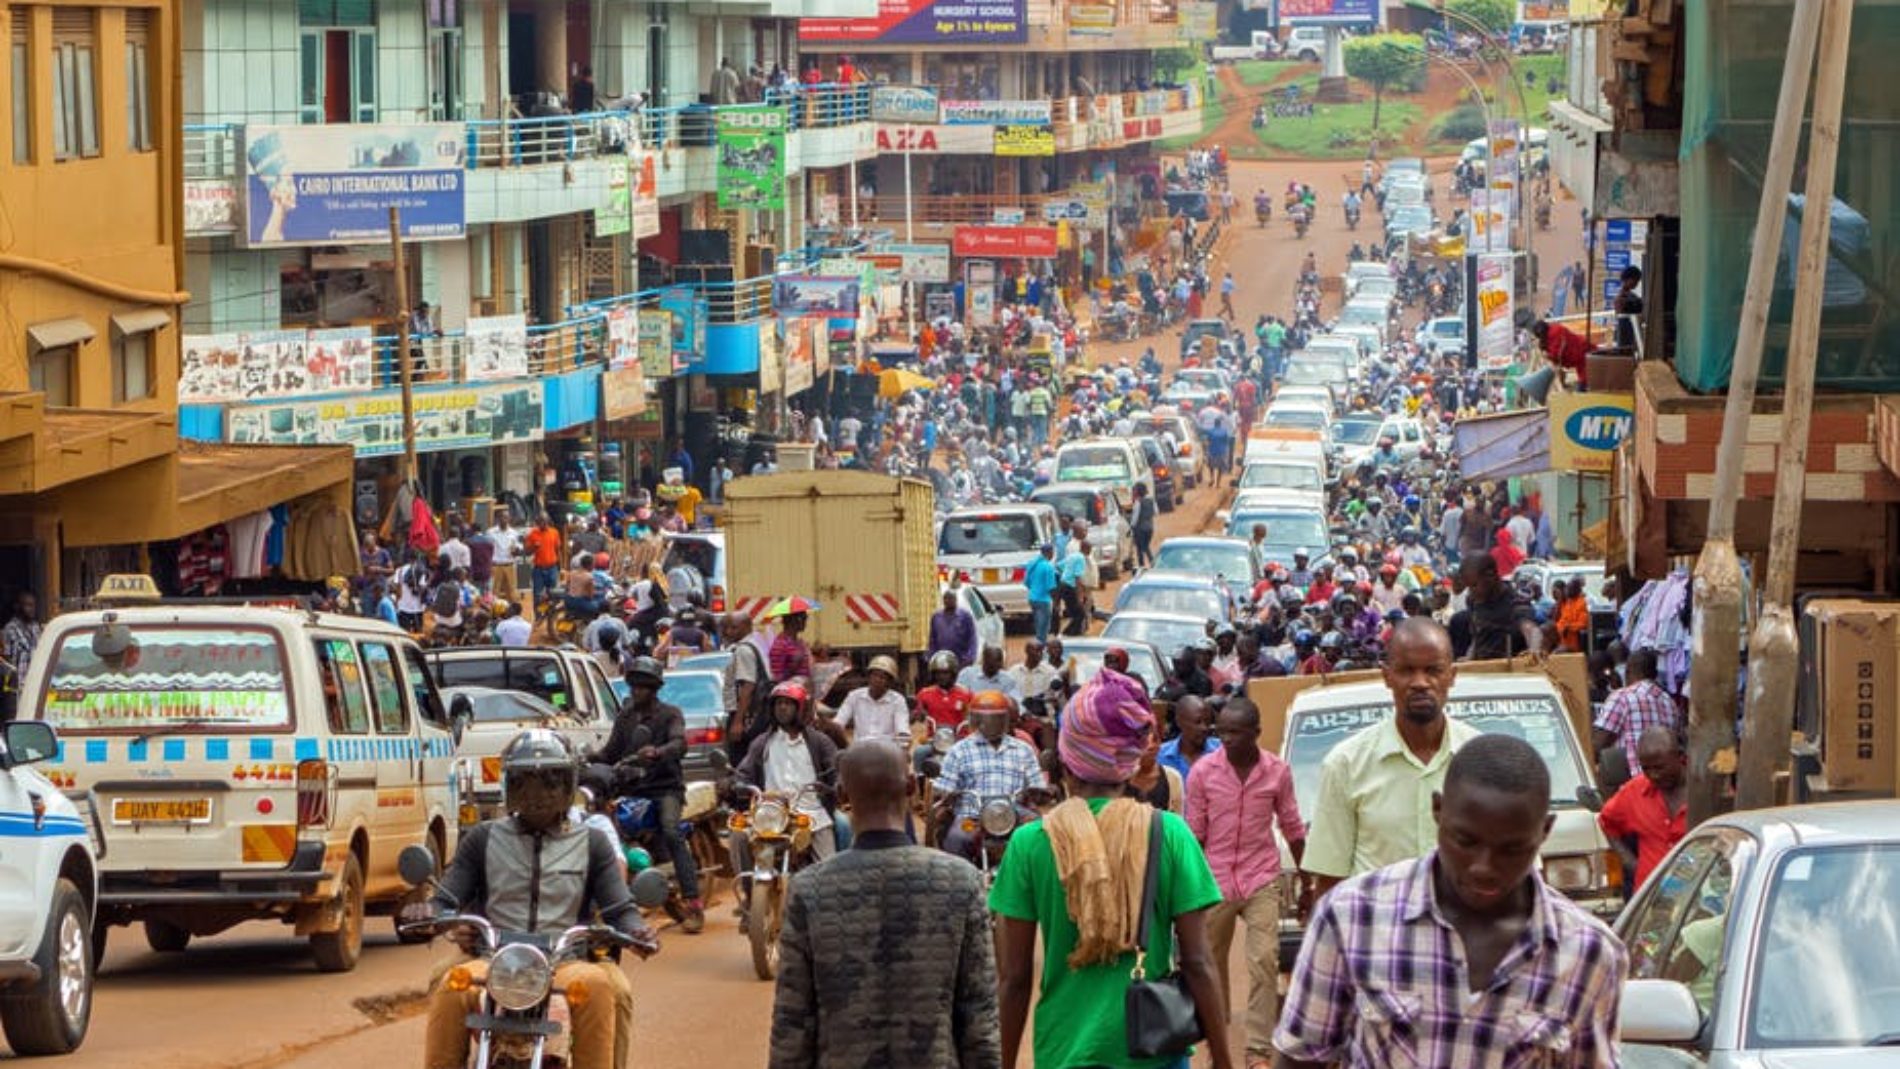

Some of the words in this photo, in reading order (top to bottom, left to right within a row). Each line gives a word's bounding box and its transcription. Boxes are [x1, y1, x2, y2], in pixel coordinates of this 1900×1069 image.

[979, 6, 1015, 17] SCHOOL
[300, 176, 330, 195] CAIRO
[332, 174, 410, 194] INTERNATIONAL
[412, 173, 438, 192] BANK
[440, 173, 458, 191] LTD
[1579, 415, 1632, 441] MTN
[110, 577, 146, 590] TAXI
